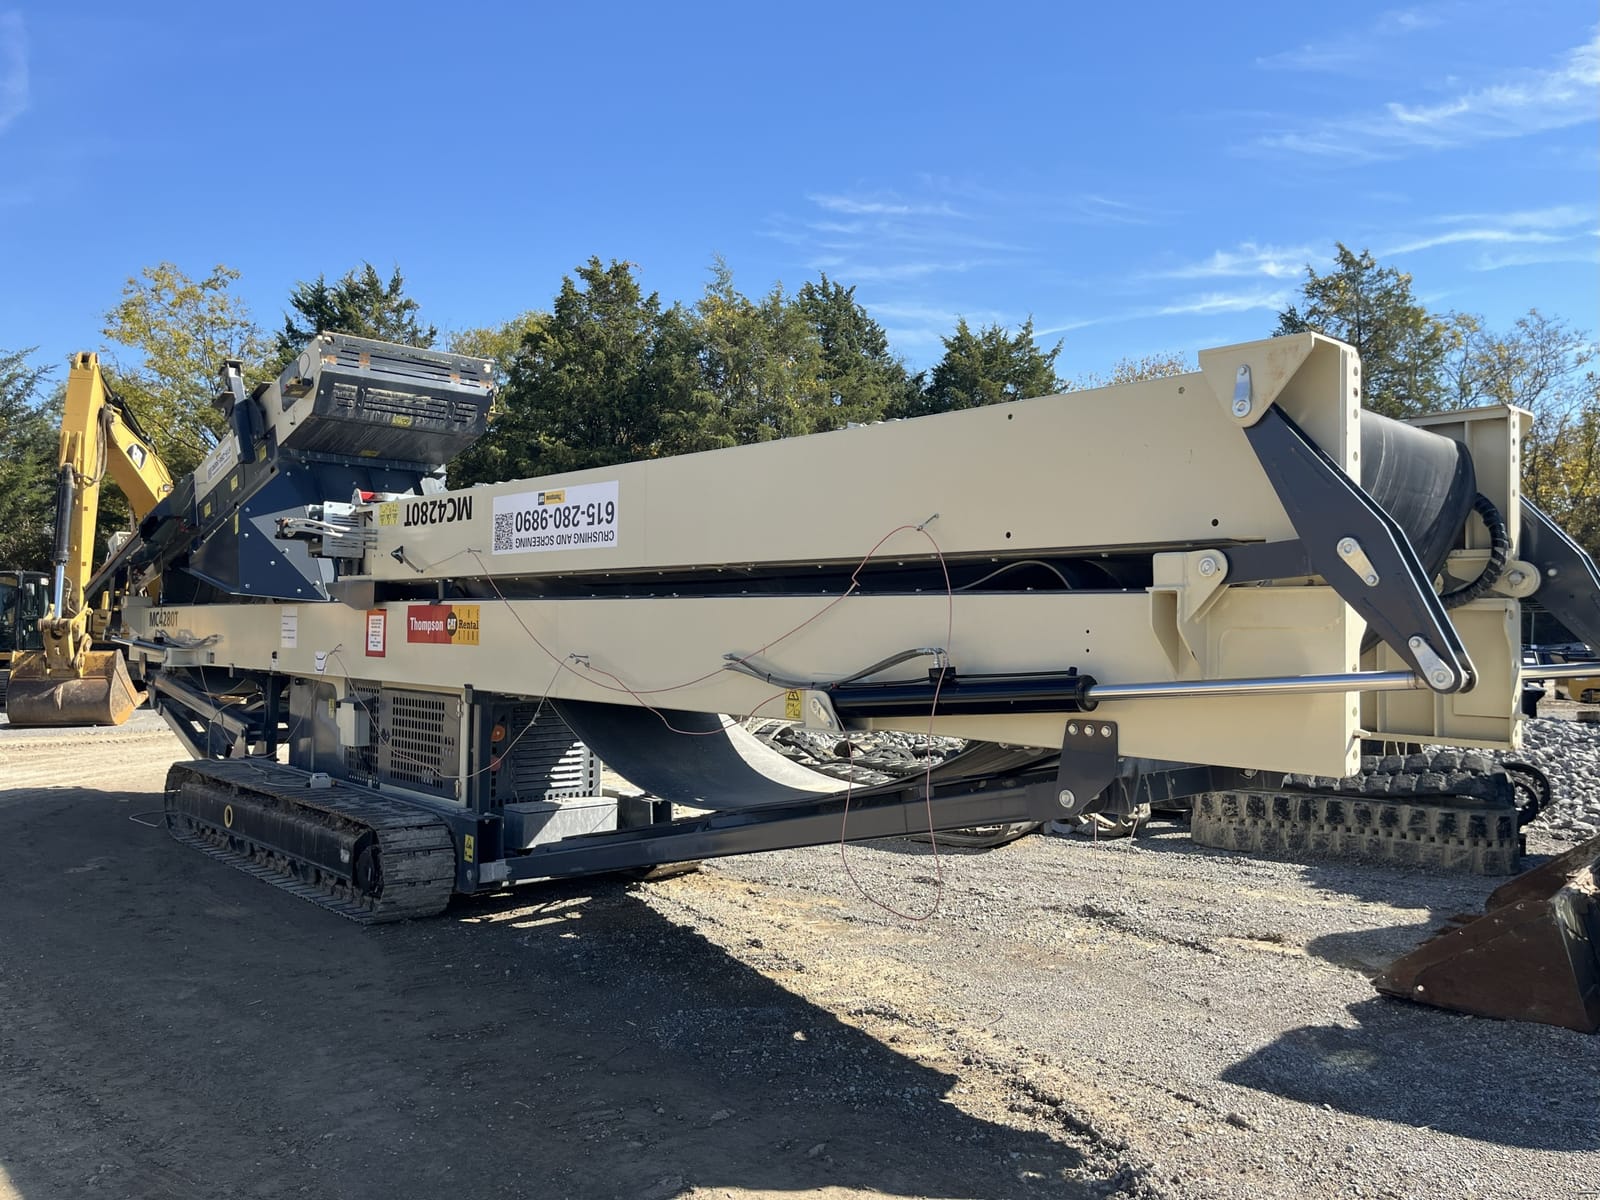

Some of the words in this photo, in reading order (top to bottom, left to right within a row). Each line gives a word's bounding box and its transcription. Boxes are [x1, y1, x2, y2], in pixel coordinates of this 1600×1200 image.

[404, 496, 472, 526] MC4280T
[515, 501, 615, 532] 615-280-9890
[515, 535, 555, 549] SCREENING
[556, 533, 572, 545] AND
[573, 530, 615, 545] CRUSHING
[149, 611, 179, 627] MC4280T
[410, 617, 443, 635] Thompson
[458, 619, 479, 630] Rental
